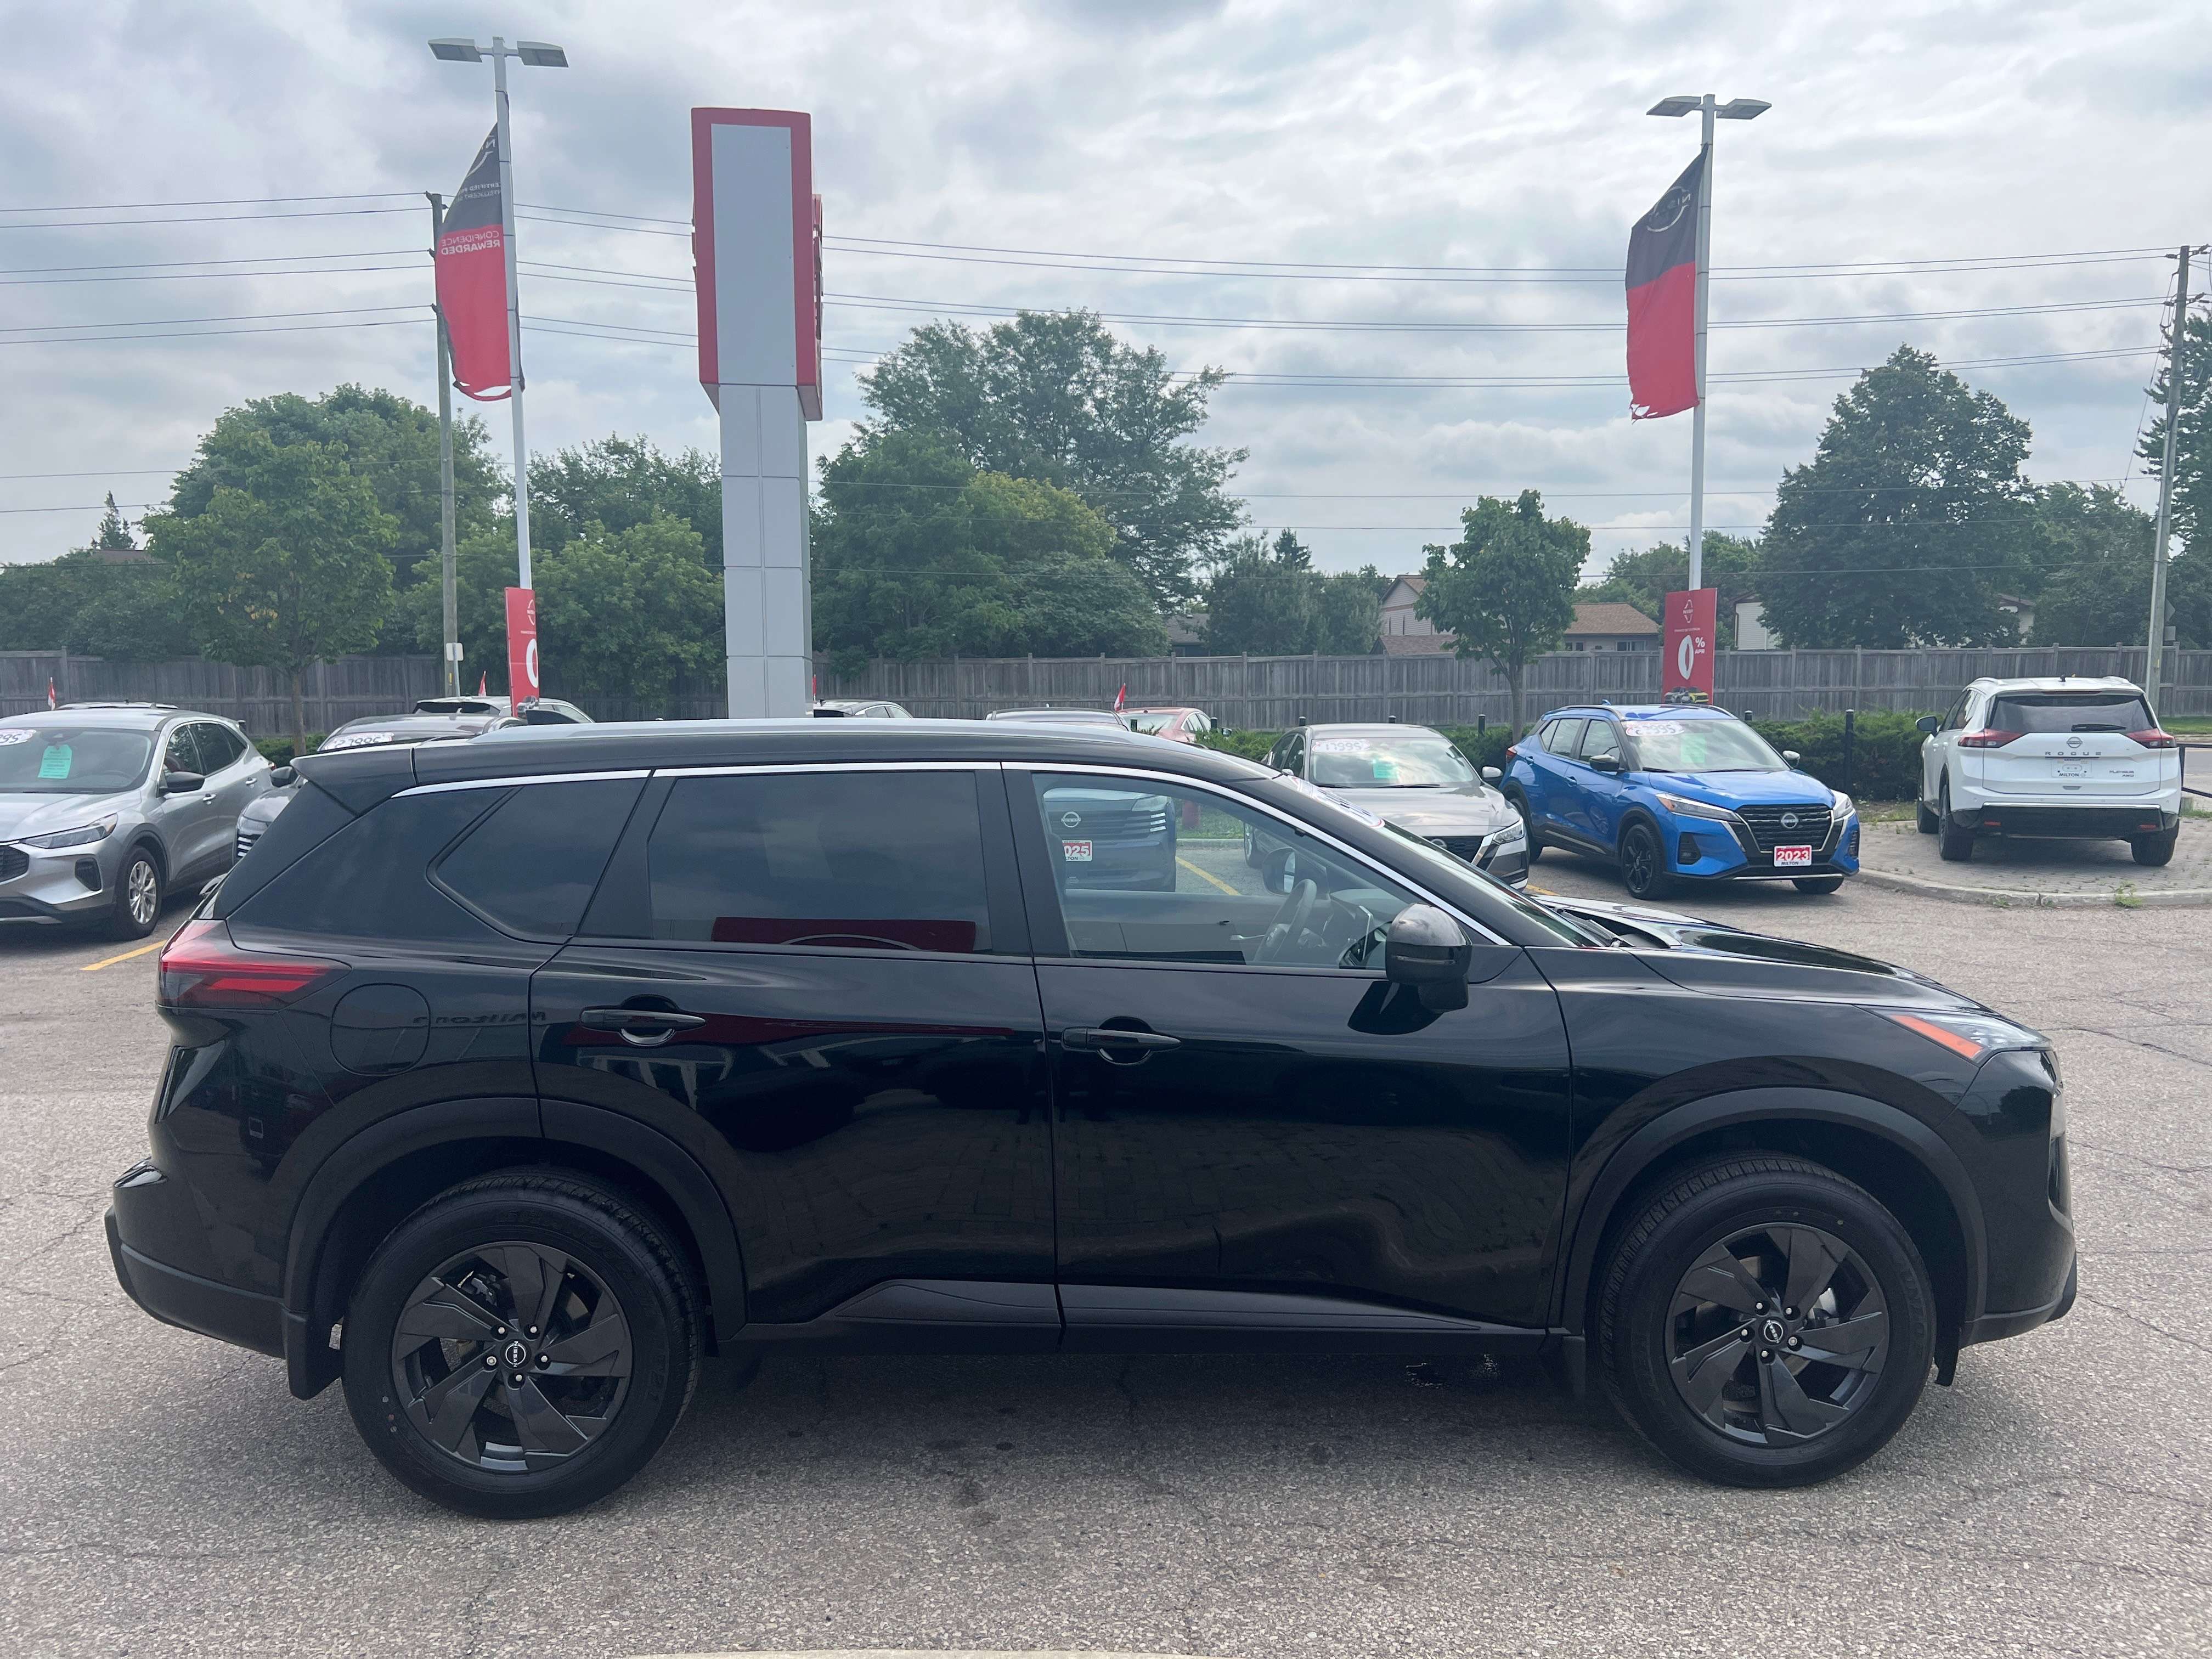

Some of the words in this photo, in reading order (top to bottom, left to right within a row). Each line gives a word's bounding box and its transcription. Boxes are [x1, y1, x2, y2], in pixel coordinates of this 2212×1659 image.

[1678, 634, 1694, 680] 0
[1695, 636, 1706, 648] %
[1064, 845, 1089, 856] 025
[1777, 850, 1809, 861] 2023
